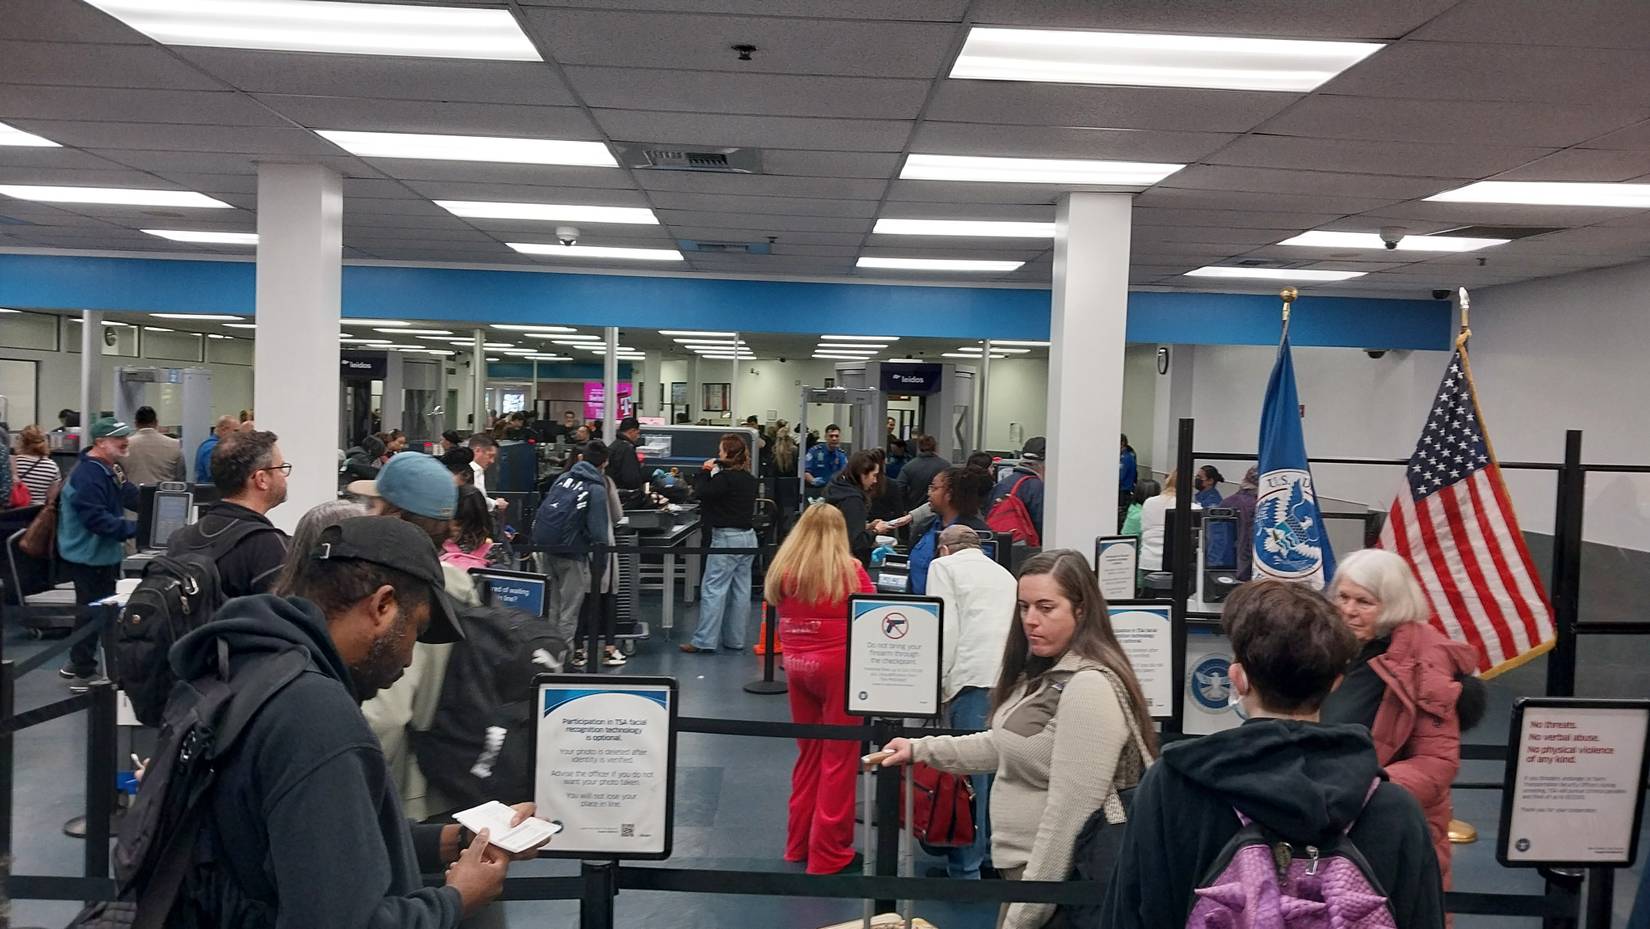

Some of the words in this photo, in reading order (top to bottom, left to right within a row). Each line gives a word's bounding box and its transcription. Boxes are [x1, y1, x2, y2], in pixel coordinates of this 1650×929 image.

[901, 375, 924, 383] leidos
[509, 588, 530, 597] waiting
[562, 718, 605, 726] Participation
[615, 718, 628, 726] TSA
[1544, 721, 1577, 729] threats.
[565, 726, 604, 734] recognition
[606, 727, 642, 735] technology
[593, 734, 622, 742] optional.
[1574, 734, 1600, 742] abuse.
[1542, 746, 1576, 755] physical
[1578, 746, 1615, 754] violence
[1537, 756, 1553, 765] any
[1555, 756, 1576, 764] kind.
[588, 770, 609, 778] officer
